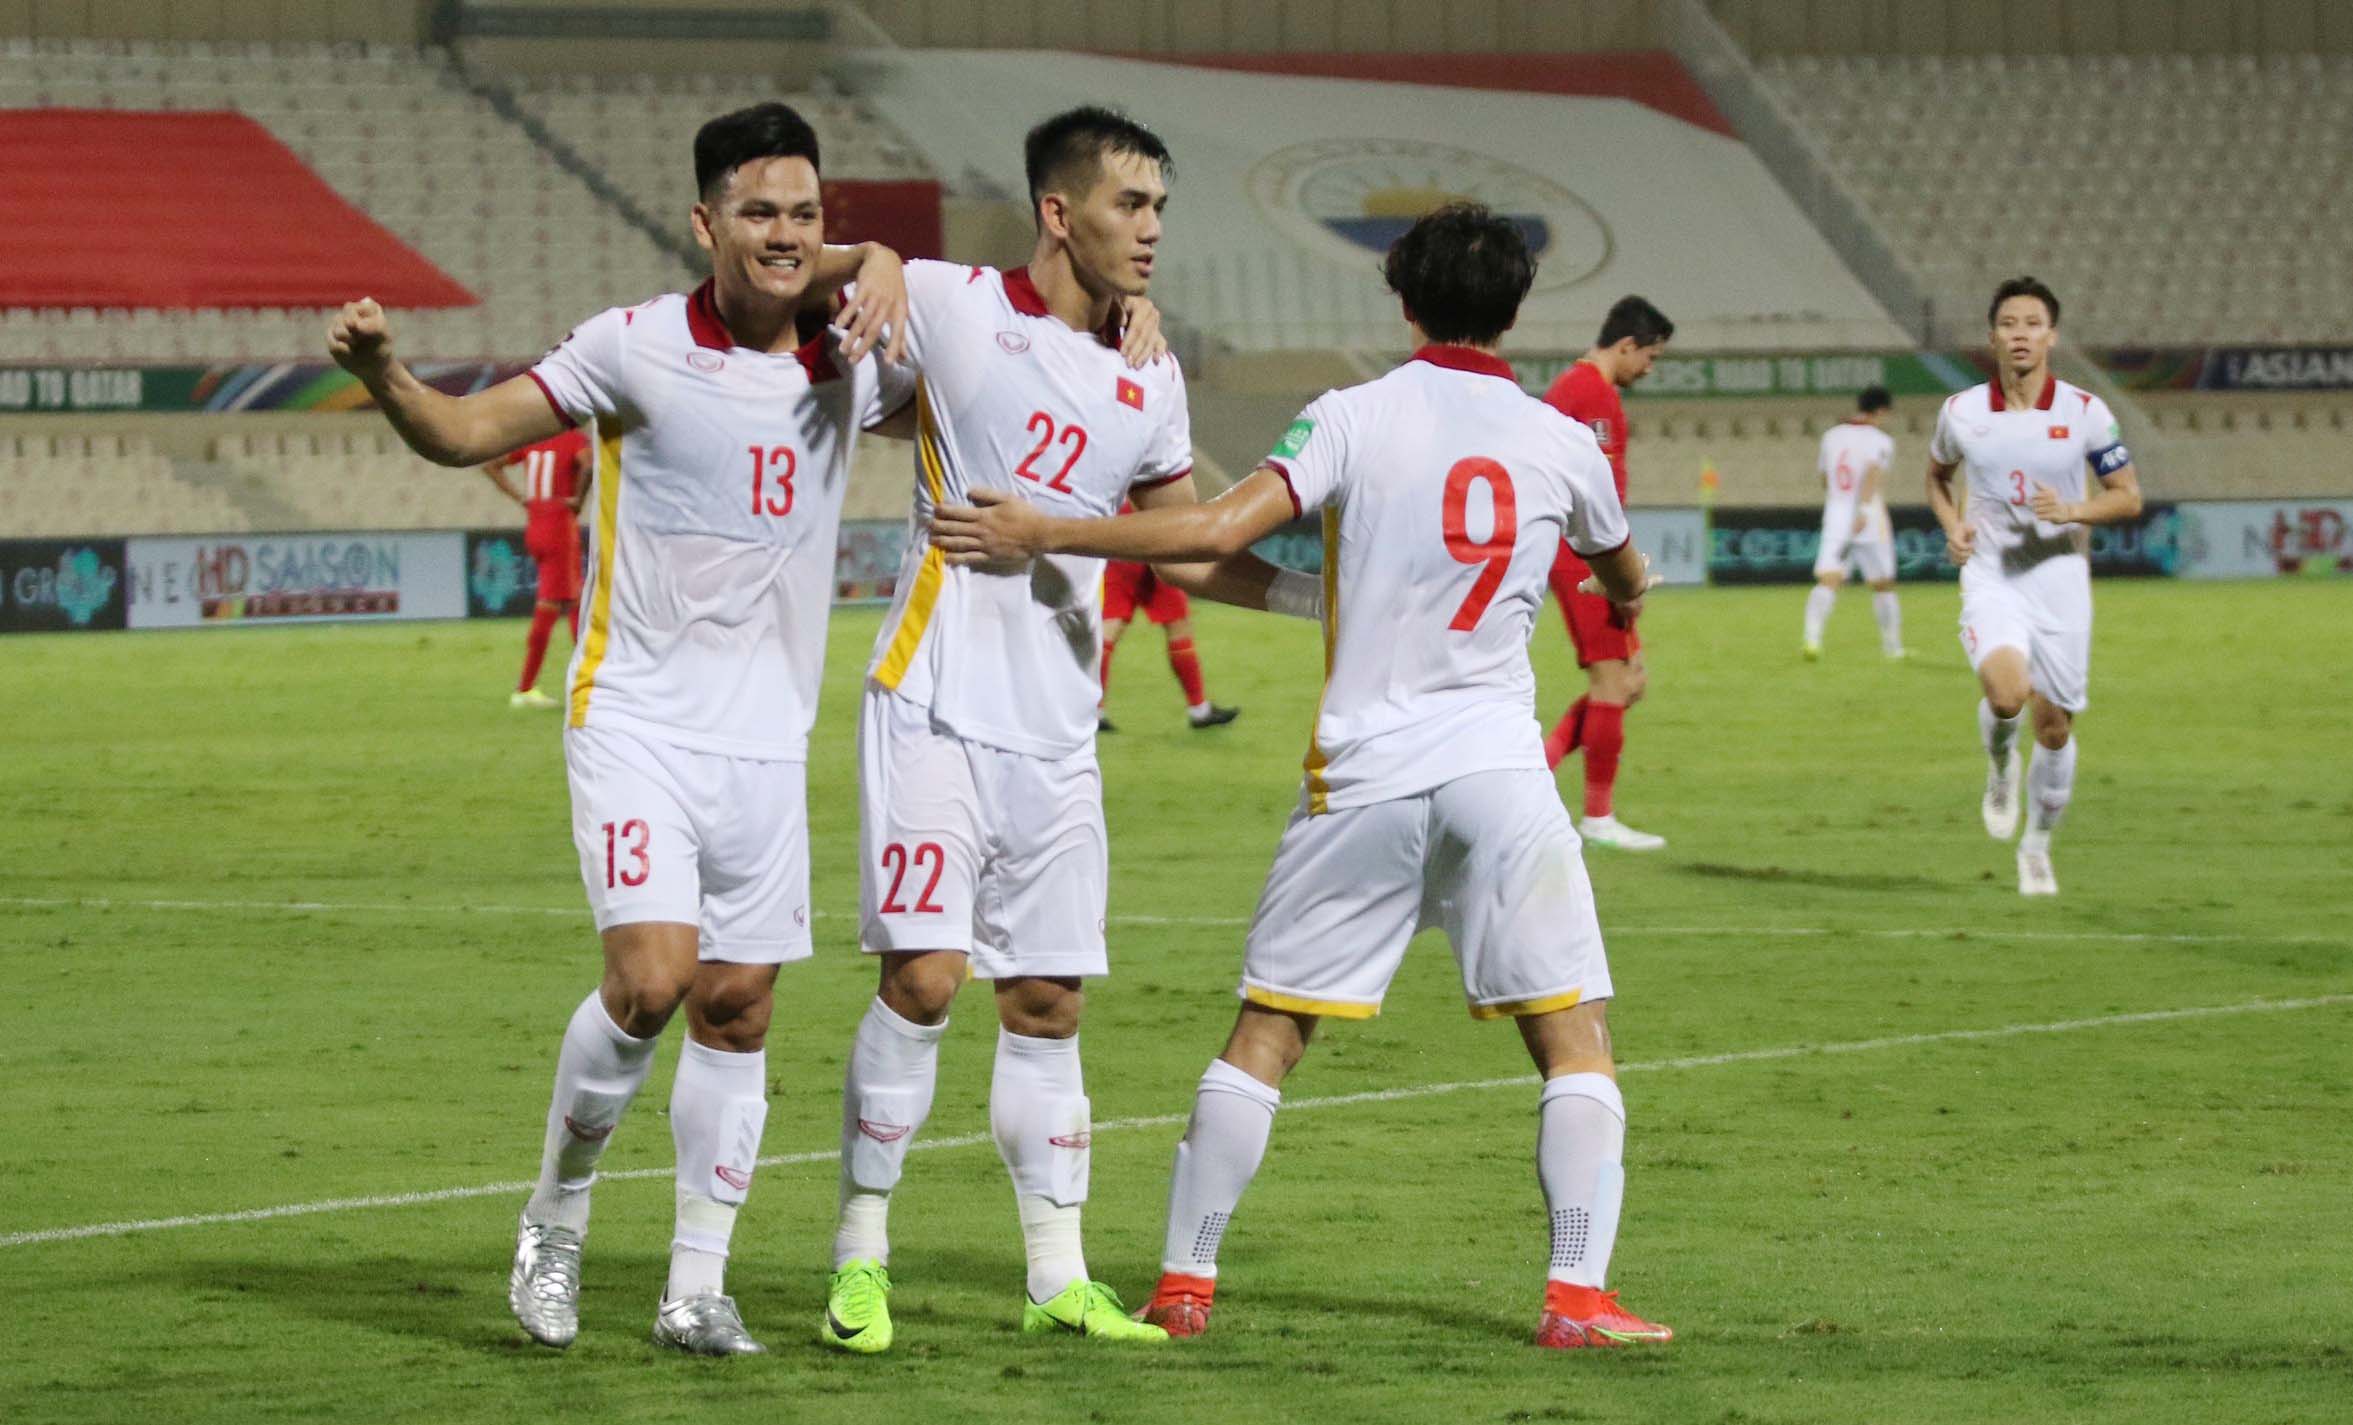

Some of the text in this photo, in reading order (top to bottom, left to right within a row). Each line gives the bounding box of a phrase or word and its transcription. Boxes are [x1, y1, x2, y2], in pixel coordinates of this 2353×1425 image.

[527, 450, 556, 499] 11
[748, 445, 796, 516] 13
[1014, 410, 1088, 494] 22
[1836, 448, 1853, 491] 6
[2009, 469, 2025, 506] 3
[196, 541, 400, 597] HD SAISON
[1442, 456, 1516, 632] 9
[602, 818, 650, 889] 13
[880, 842, 945, 914] 22
